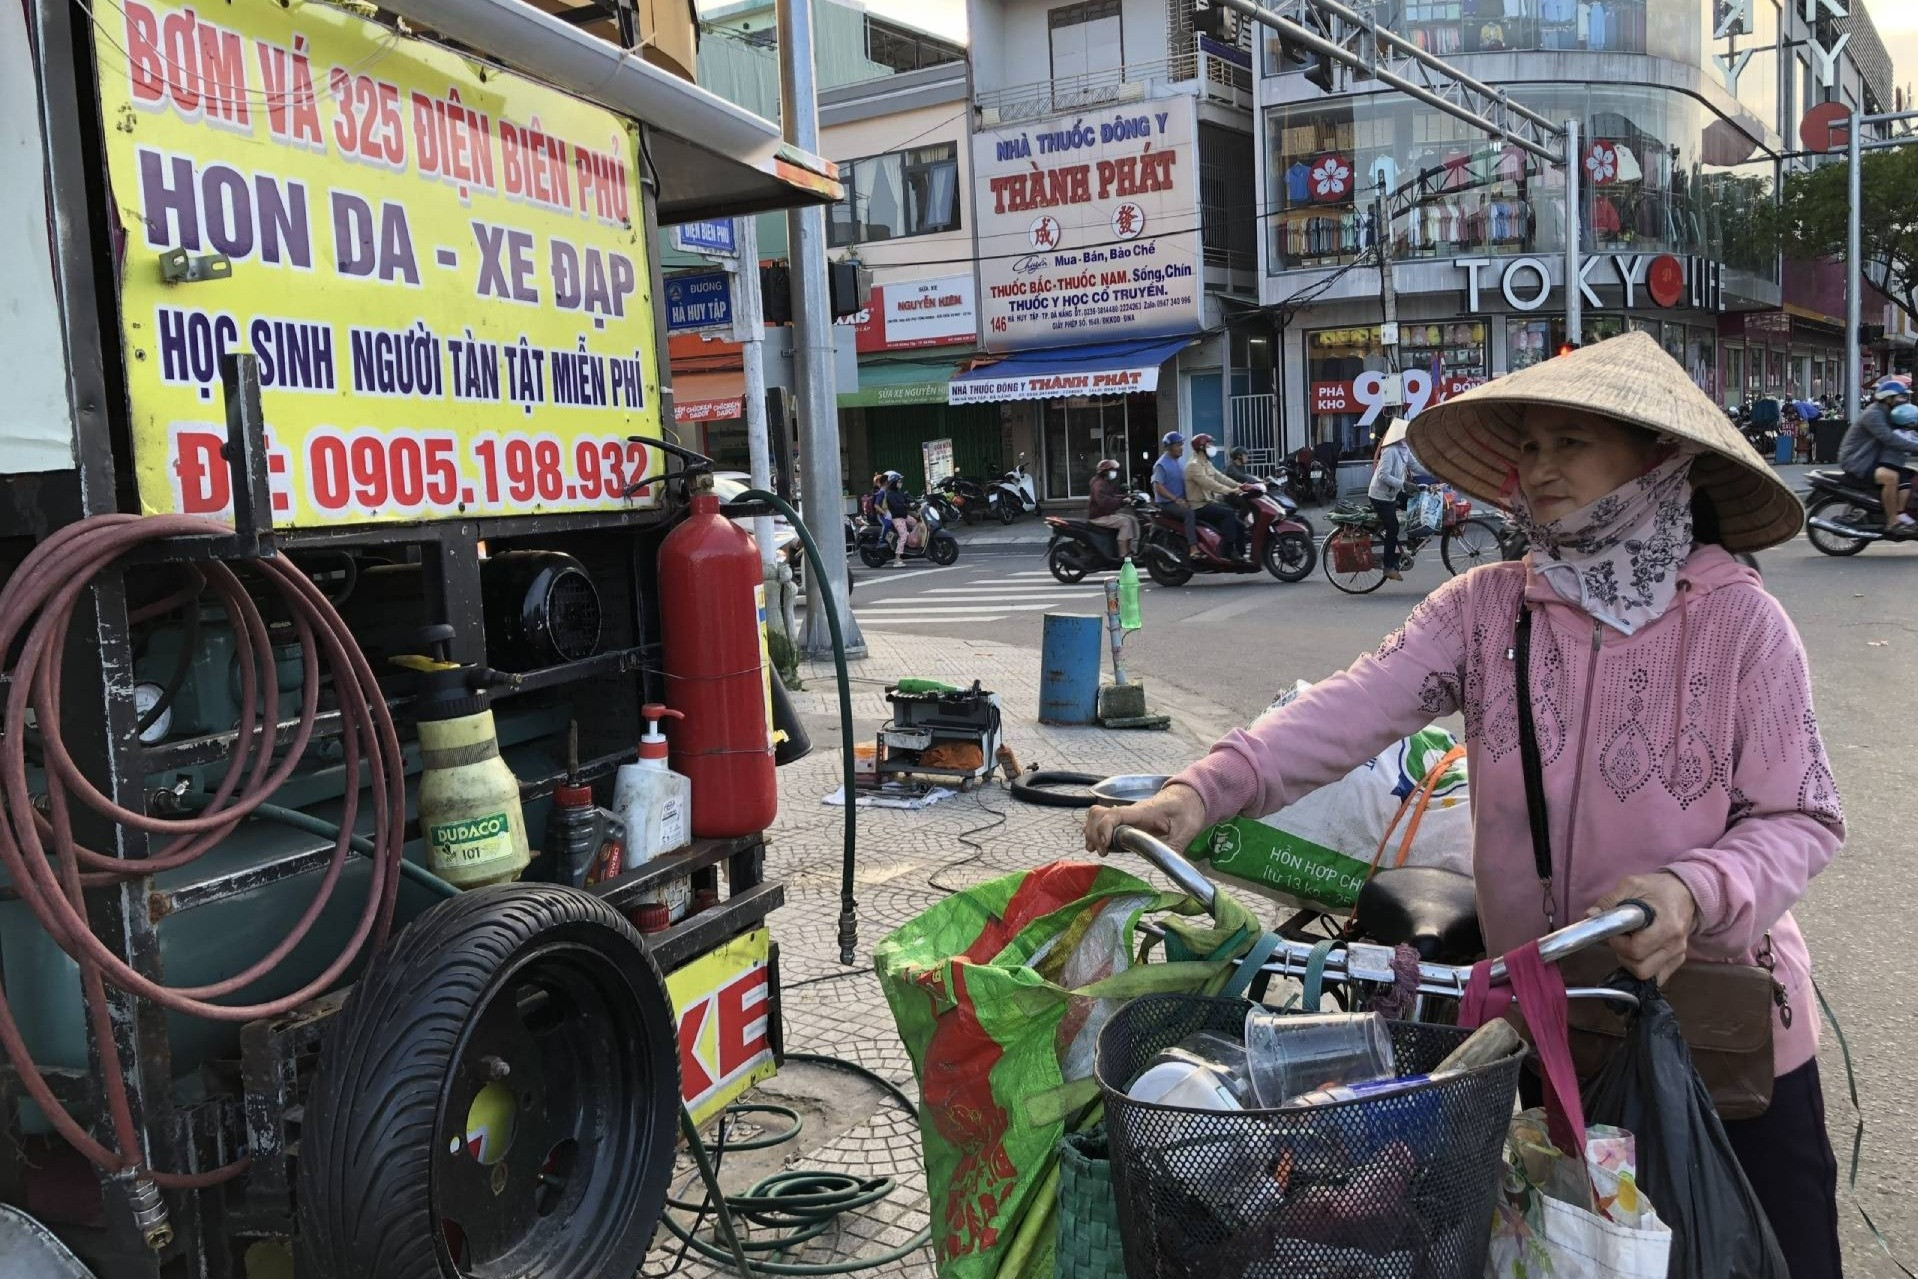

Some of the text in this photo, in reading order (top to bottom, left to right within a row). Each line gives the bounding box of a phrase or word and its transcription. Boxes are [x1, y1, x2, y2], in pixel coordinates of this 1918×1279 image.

[124, 0, 630, 223] BƠM VÁ 325 ĐIỆN BIÊN PHỦ
[996, 112, 1169, 162] NHÀ THUỐC ĐÔNG Y
[990, 142, 1176, 214] THÀNH PHÁT
[138, 149, 312, 268] HON
[331, 192, 420, 285] DA
[472, 221, 538, 303] XE
[550, 239, 635, 329] ĐẠP
[1035, 217, 1054, 247] 成
[1133, 239, 1156, 256] Chế
[990, 278, 1027, 298] THUỐC
[1100, 270, 1131, 286] NAM.
[1008, 281, 1168, 312] THUỐC Y HỌC CỔ TRUYỀN.
[1687, 255, 1726, 312] LIFE
[672, 298, 726, 323] HÀ HUY TẬP
[991, 315, 1007, 333] 146
[159, 309, 644, 413] HỌC SINH NGƯỜI TÀN TẬT MIỄN PHÍ
[952, 371, 1142, 395] NHÀ THUỐC ĐÔNG Y THÀNH PHÁT
[1318, 384, 1345, 398] PHÁ
[1318, 399, 1346, 410] KHO
[176, 432, 651, 514] Đ: 0905.198.932
